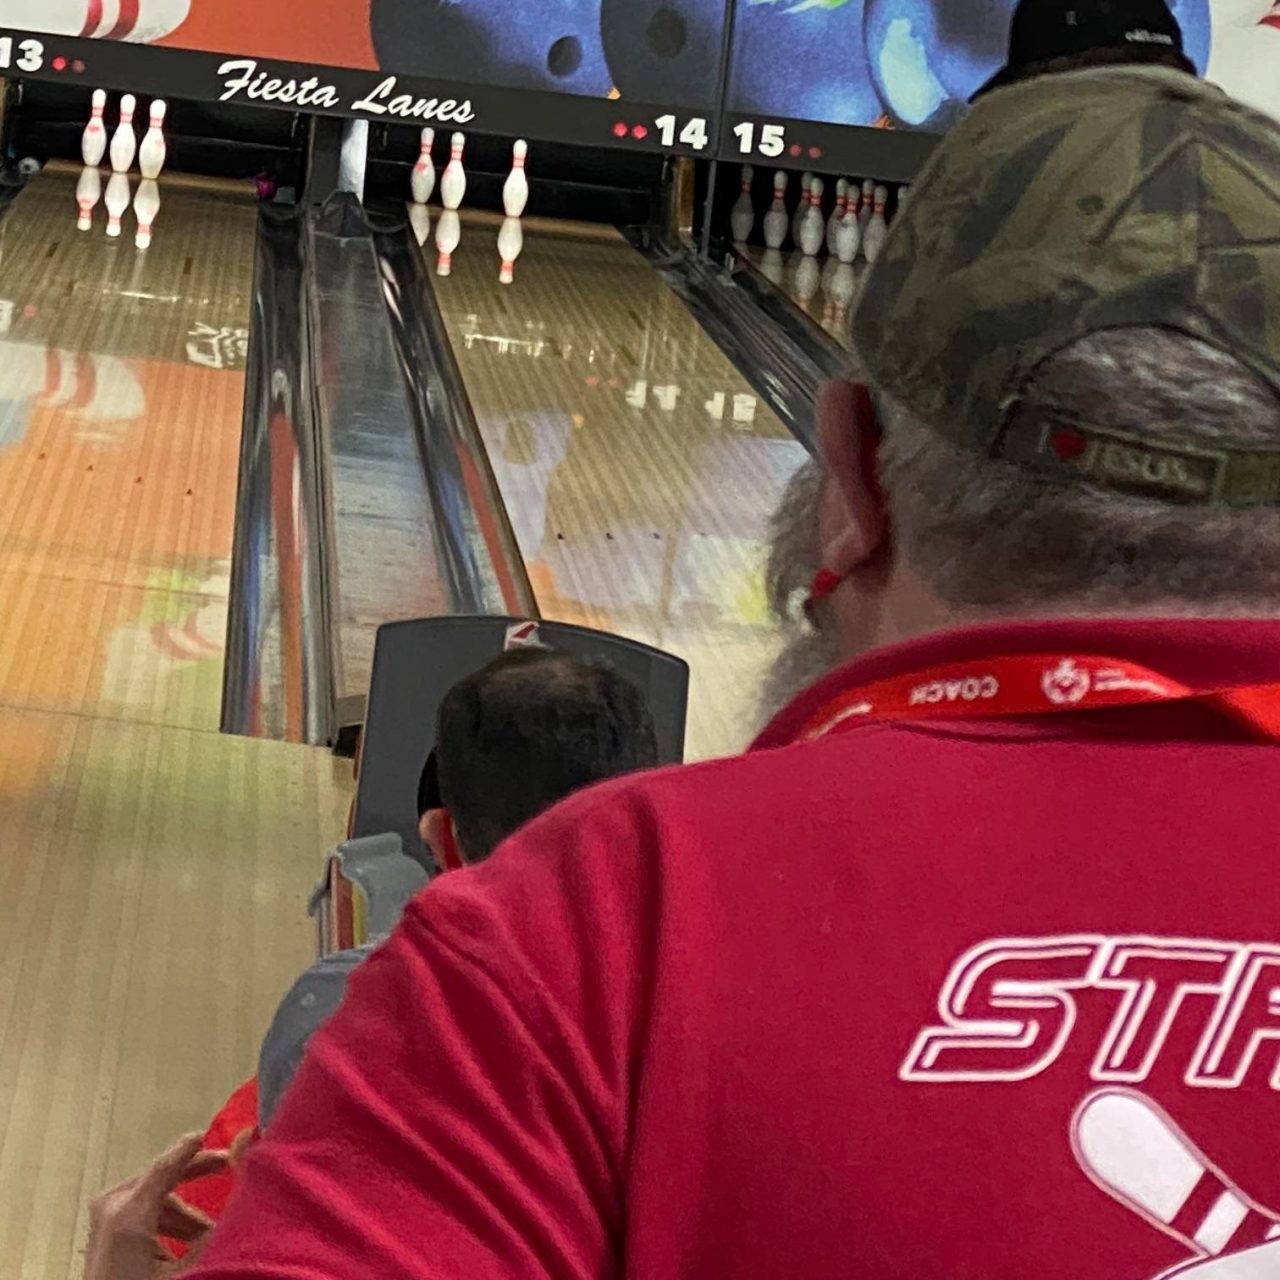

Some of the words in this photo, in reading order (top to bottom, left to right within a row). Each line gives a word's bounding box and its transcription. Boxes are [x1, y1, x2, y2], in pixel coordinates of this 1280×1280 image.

[216, 59, 340, 109] Fiesta
[351, 75, 476, 125] Lanes
[654, 114, 709, 151] 14
[733, 120, 785, 159] 15
[907, 673, 1000, 706] COACH
